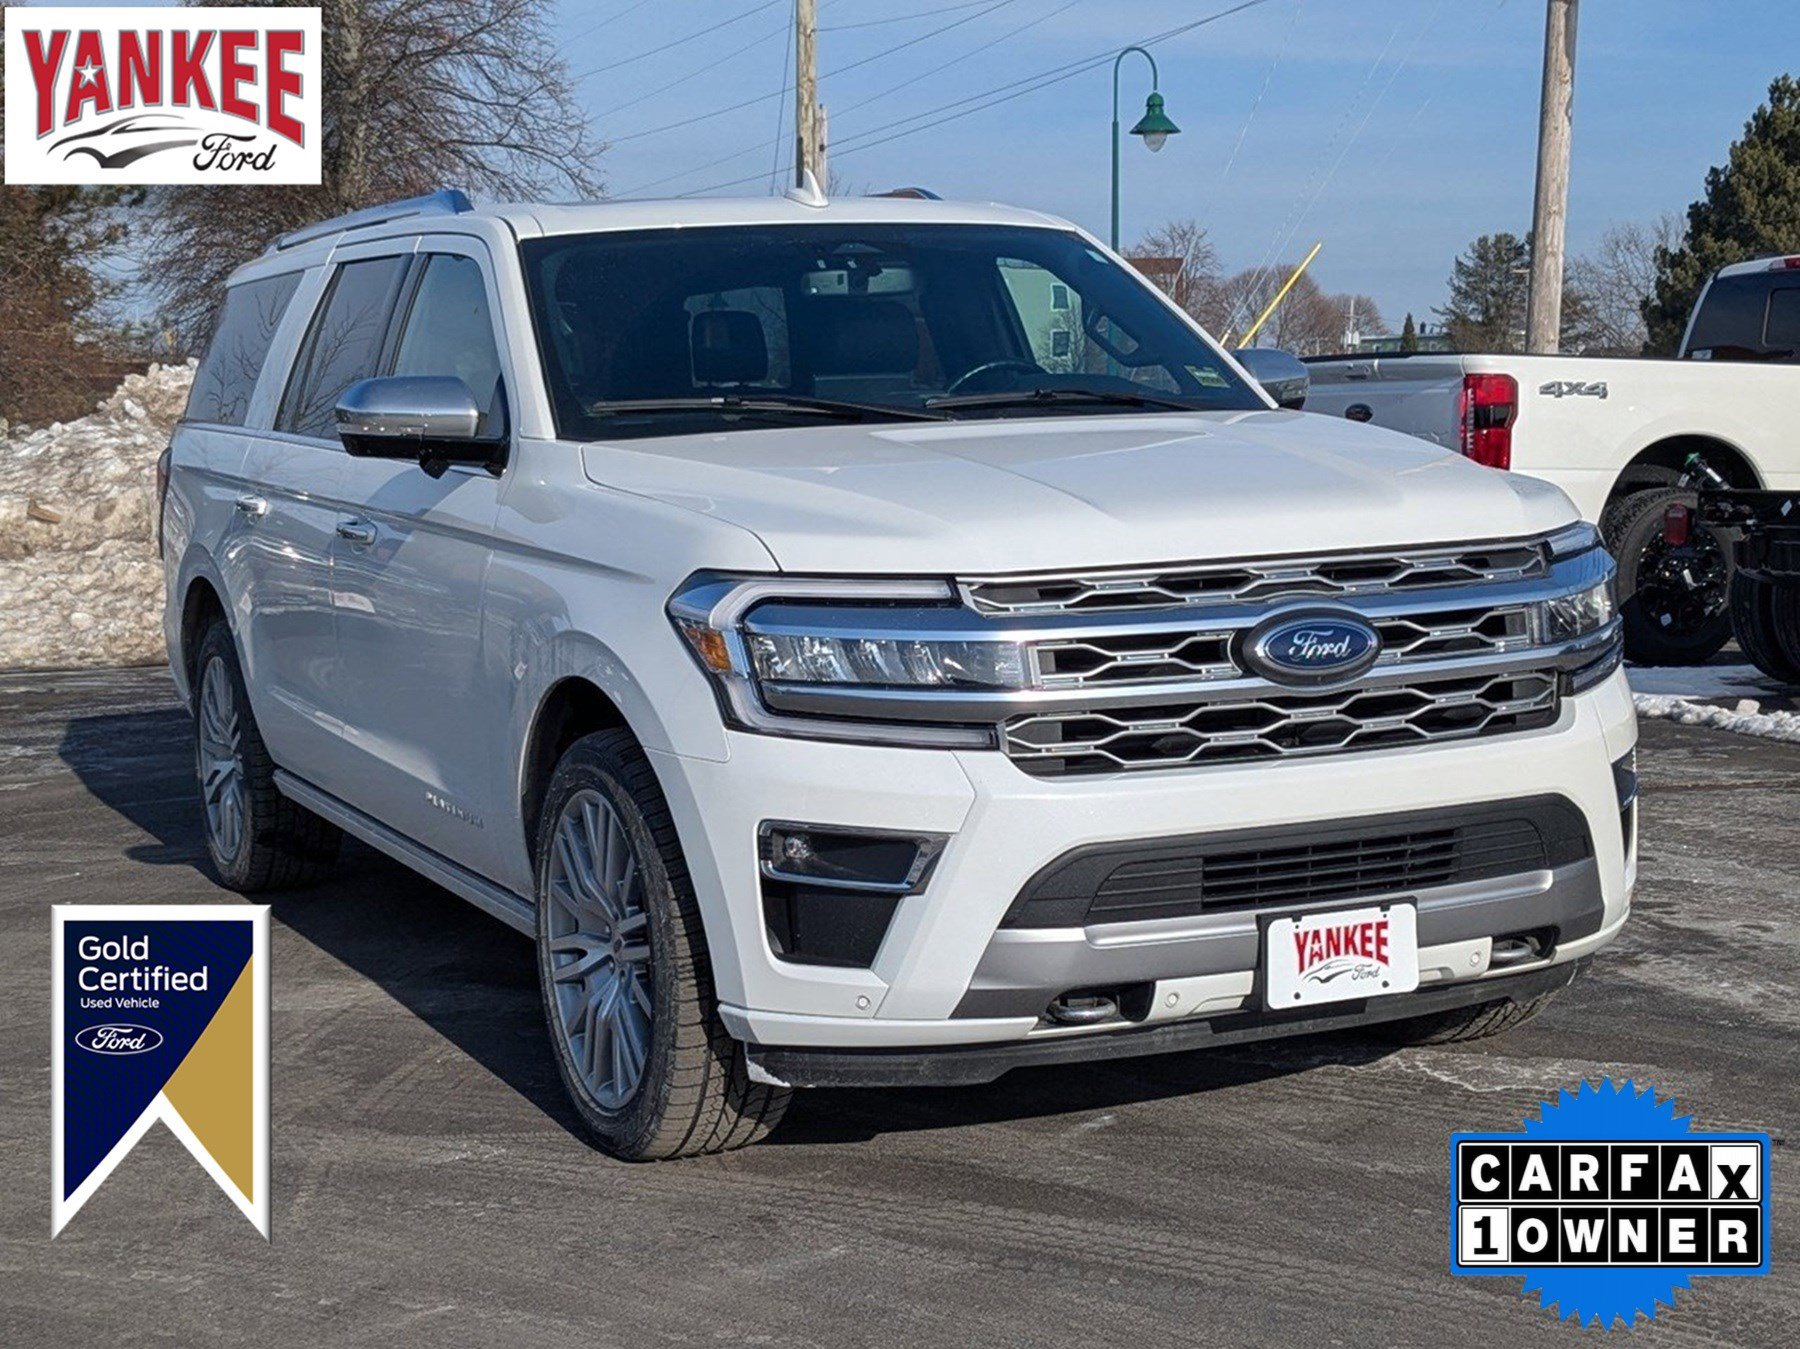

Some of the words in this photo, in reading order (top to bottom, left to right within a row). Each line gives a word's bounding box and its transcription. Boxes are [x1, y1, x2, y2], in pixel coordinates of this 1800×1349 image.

[1288, 629, 1351, 661] Ford
[1294, 920, 1390, 975] YANKEE
[1351, 964, 1380, 981] Ford
